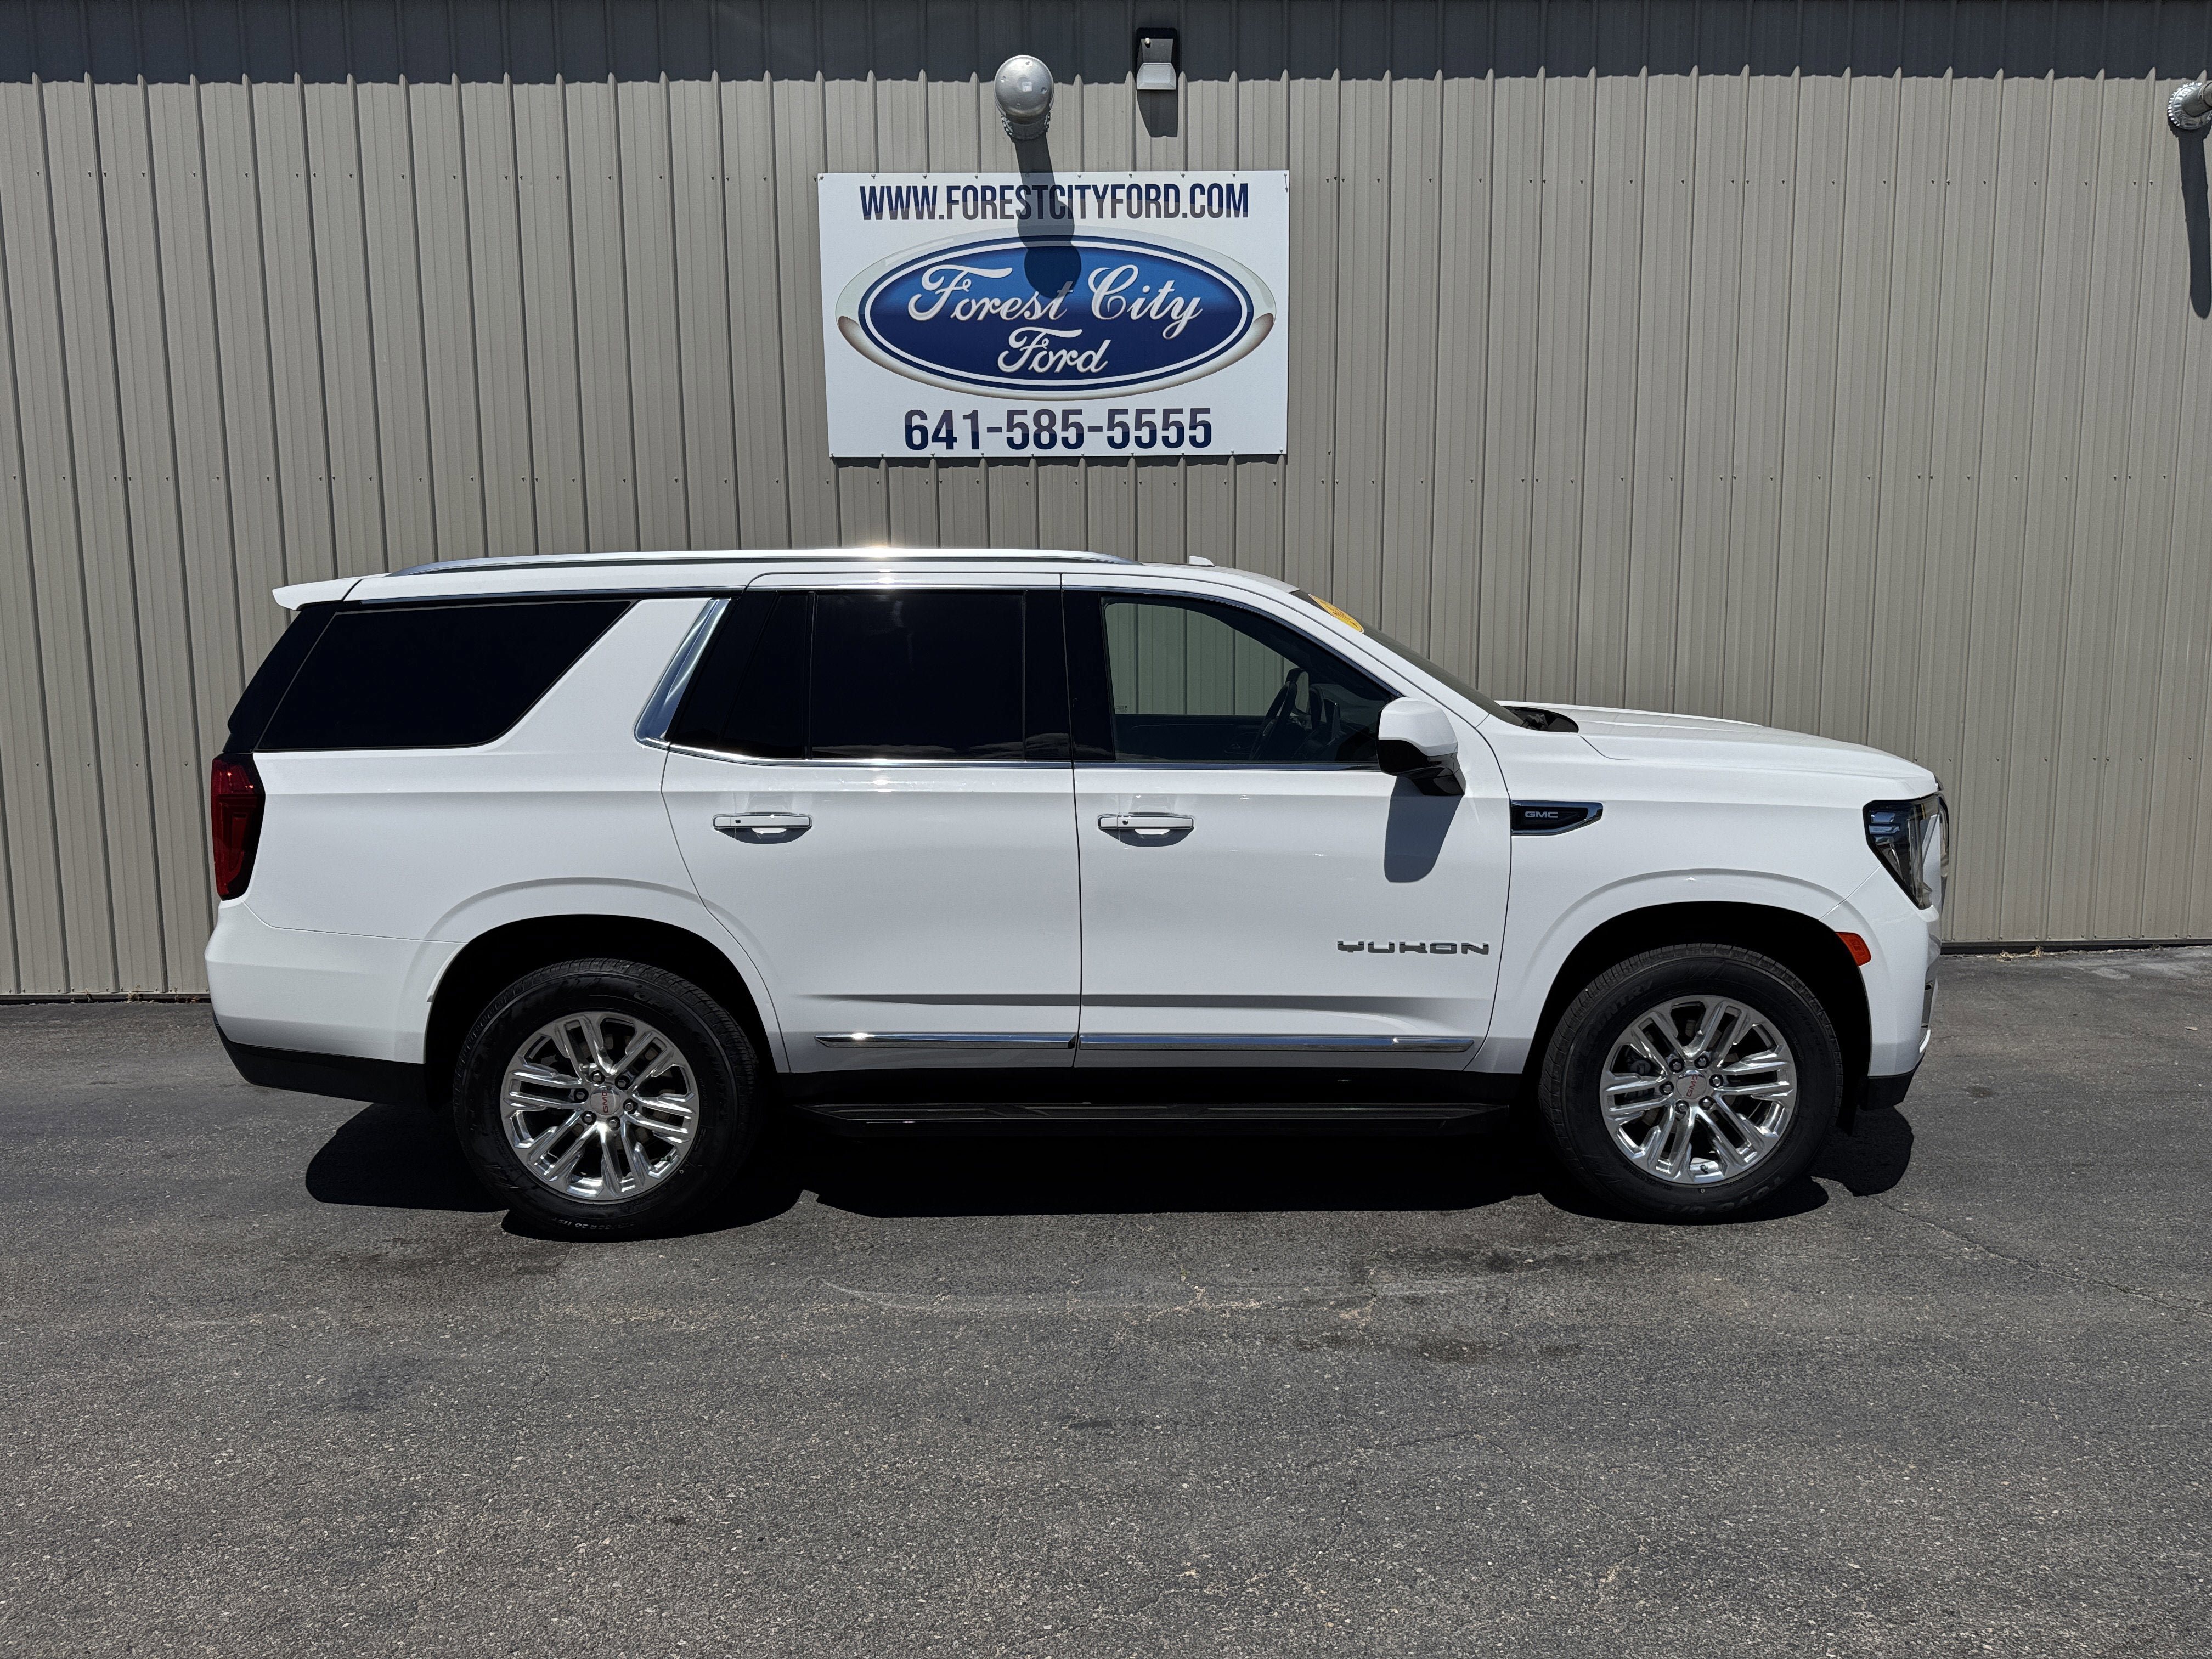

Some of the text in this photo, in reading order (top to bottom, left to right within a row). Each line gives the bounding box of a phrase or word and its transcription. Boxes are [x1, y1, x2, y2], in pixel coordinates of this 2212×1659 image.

[860, 182, 1249, 221] WWW.FORESTCITYFORD.COM
[907, 264, 1204, 340] Forest City
[997, 326, 1112, 374] Ford
[904, 408, 1212, 451] 641-585-5555
[1336, 939, 1489, 955] YUKON
